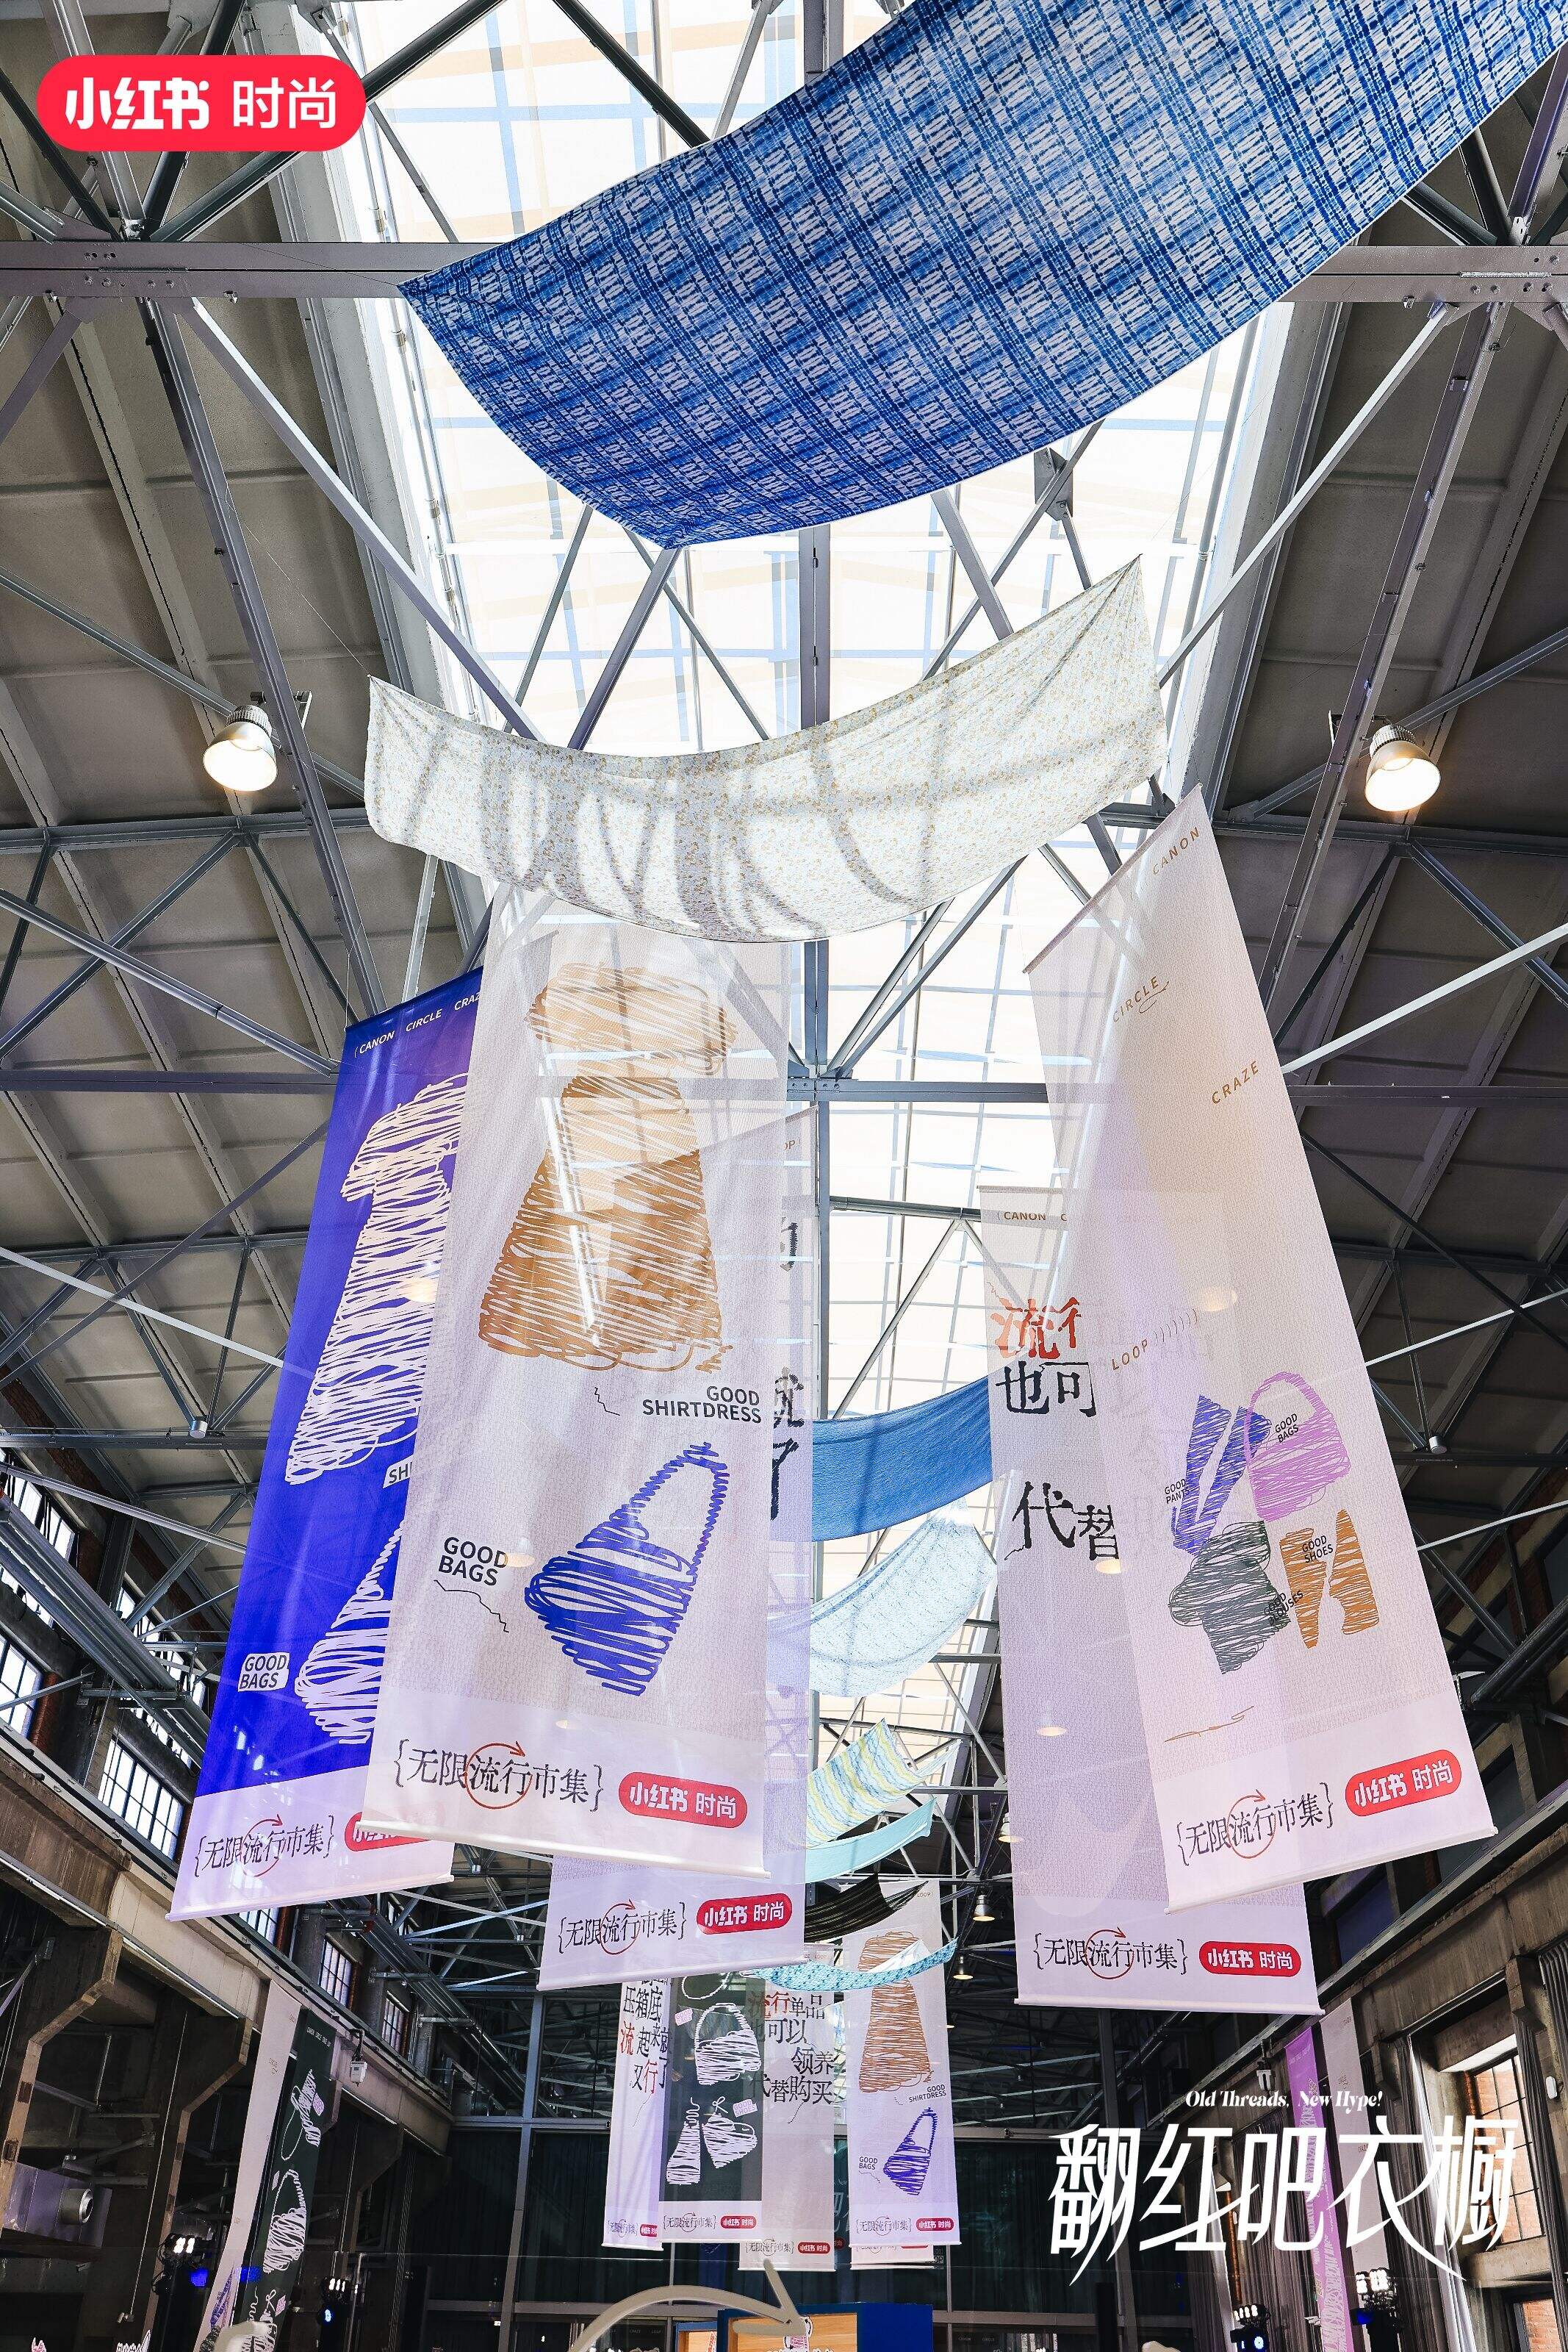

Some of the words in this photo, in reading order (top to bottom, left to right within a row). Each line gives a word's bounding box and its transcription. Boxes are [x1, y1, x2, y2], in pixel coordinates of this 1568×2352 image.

[1152, 826, 1201, 875] CANON
[1112, 975, 1159, 1023] CIRCLE
[406, 1009, 442, 1032] CIRCLE
[1212, 1060, 1259, 1105] CRAZE
[706, 1385, 760, 1406] GOOD
[642, 1399, 762, 1424] SHIRTDRESS
[1275, 1413, 1298, 1434] GOOD
[1277, 1424, 1299, 1444] BAGS
[1165, 1478, 1187, 1495] GOOD
[443, 1536, 508, 1568] GOOD
[1302, 1535, 1328, 1554] GOOD
[1304, 1544, 1334, 1564] SHOES
[438, 1555, 498, 1587] BAGS
[244, 1654, 287, 1671] GOOD
[240, 1671, 279, 1690] BAGS
[1353, 1771, 1407, 1808] 小红书
[1411, 1760, 1455, 1796] 时尚
[629, 1780, 689, 1813] 小红书
[695, 1793, 737, 1820] 时尚
[703, 1905, 748, 1927] 小红书
[753, 1901, 785, 1923] 时尚
[1207, 1948, 1254, 1970] 小红书
[1259, 1951, 1294, 1971] 时尚
[908, 2090, 947, 2103] SHIRTDRESS
[927, 2084, 946, 2093] GOOD
[858, 2162, 876, 2170] BAGS
[859, 2156, 878, 2164] GOOD
